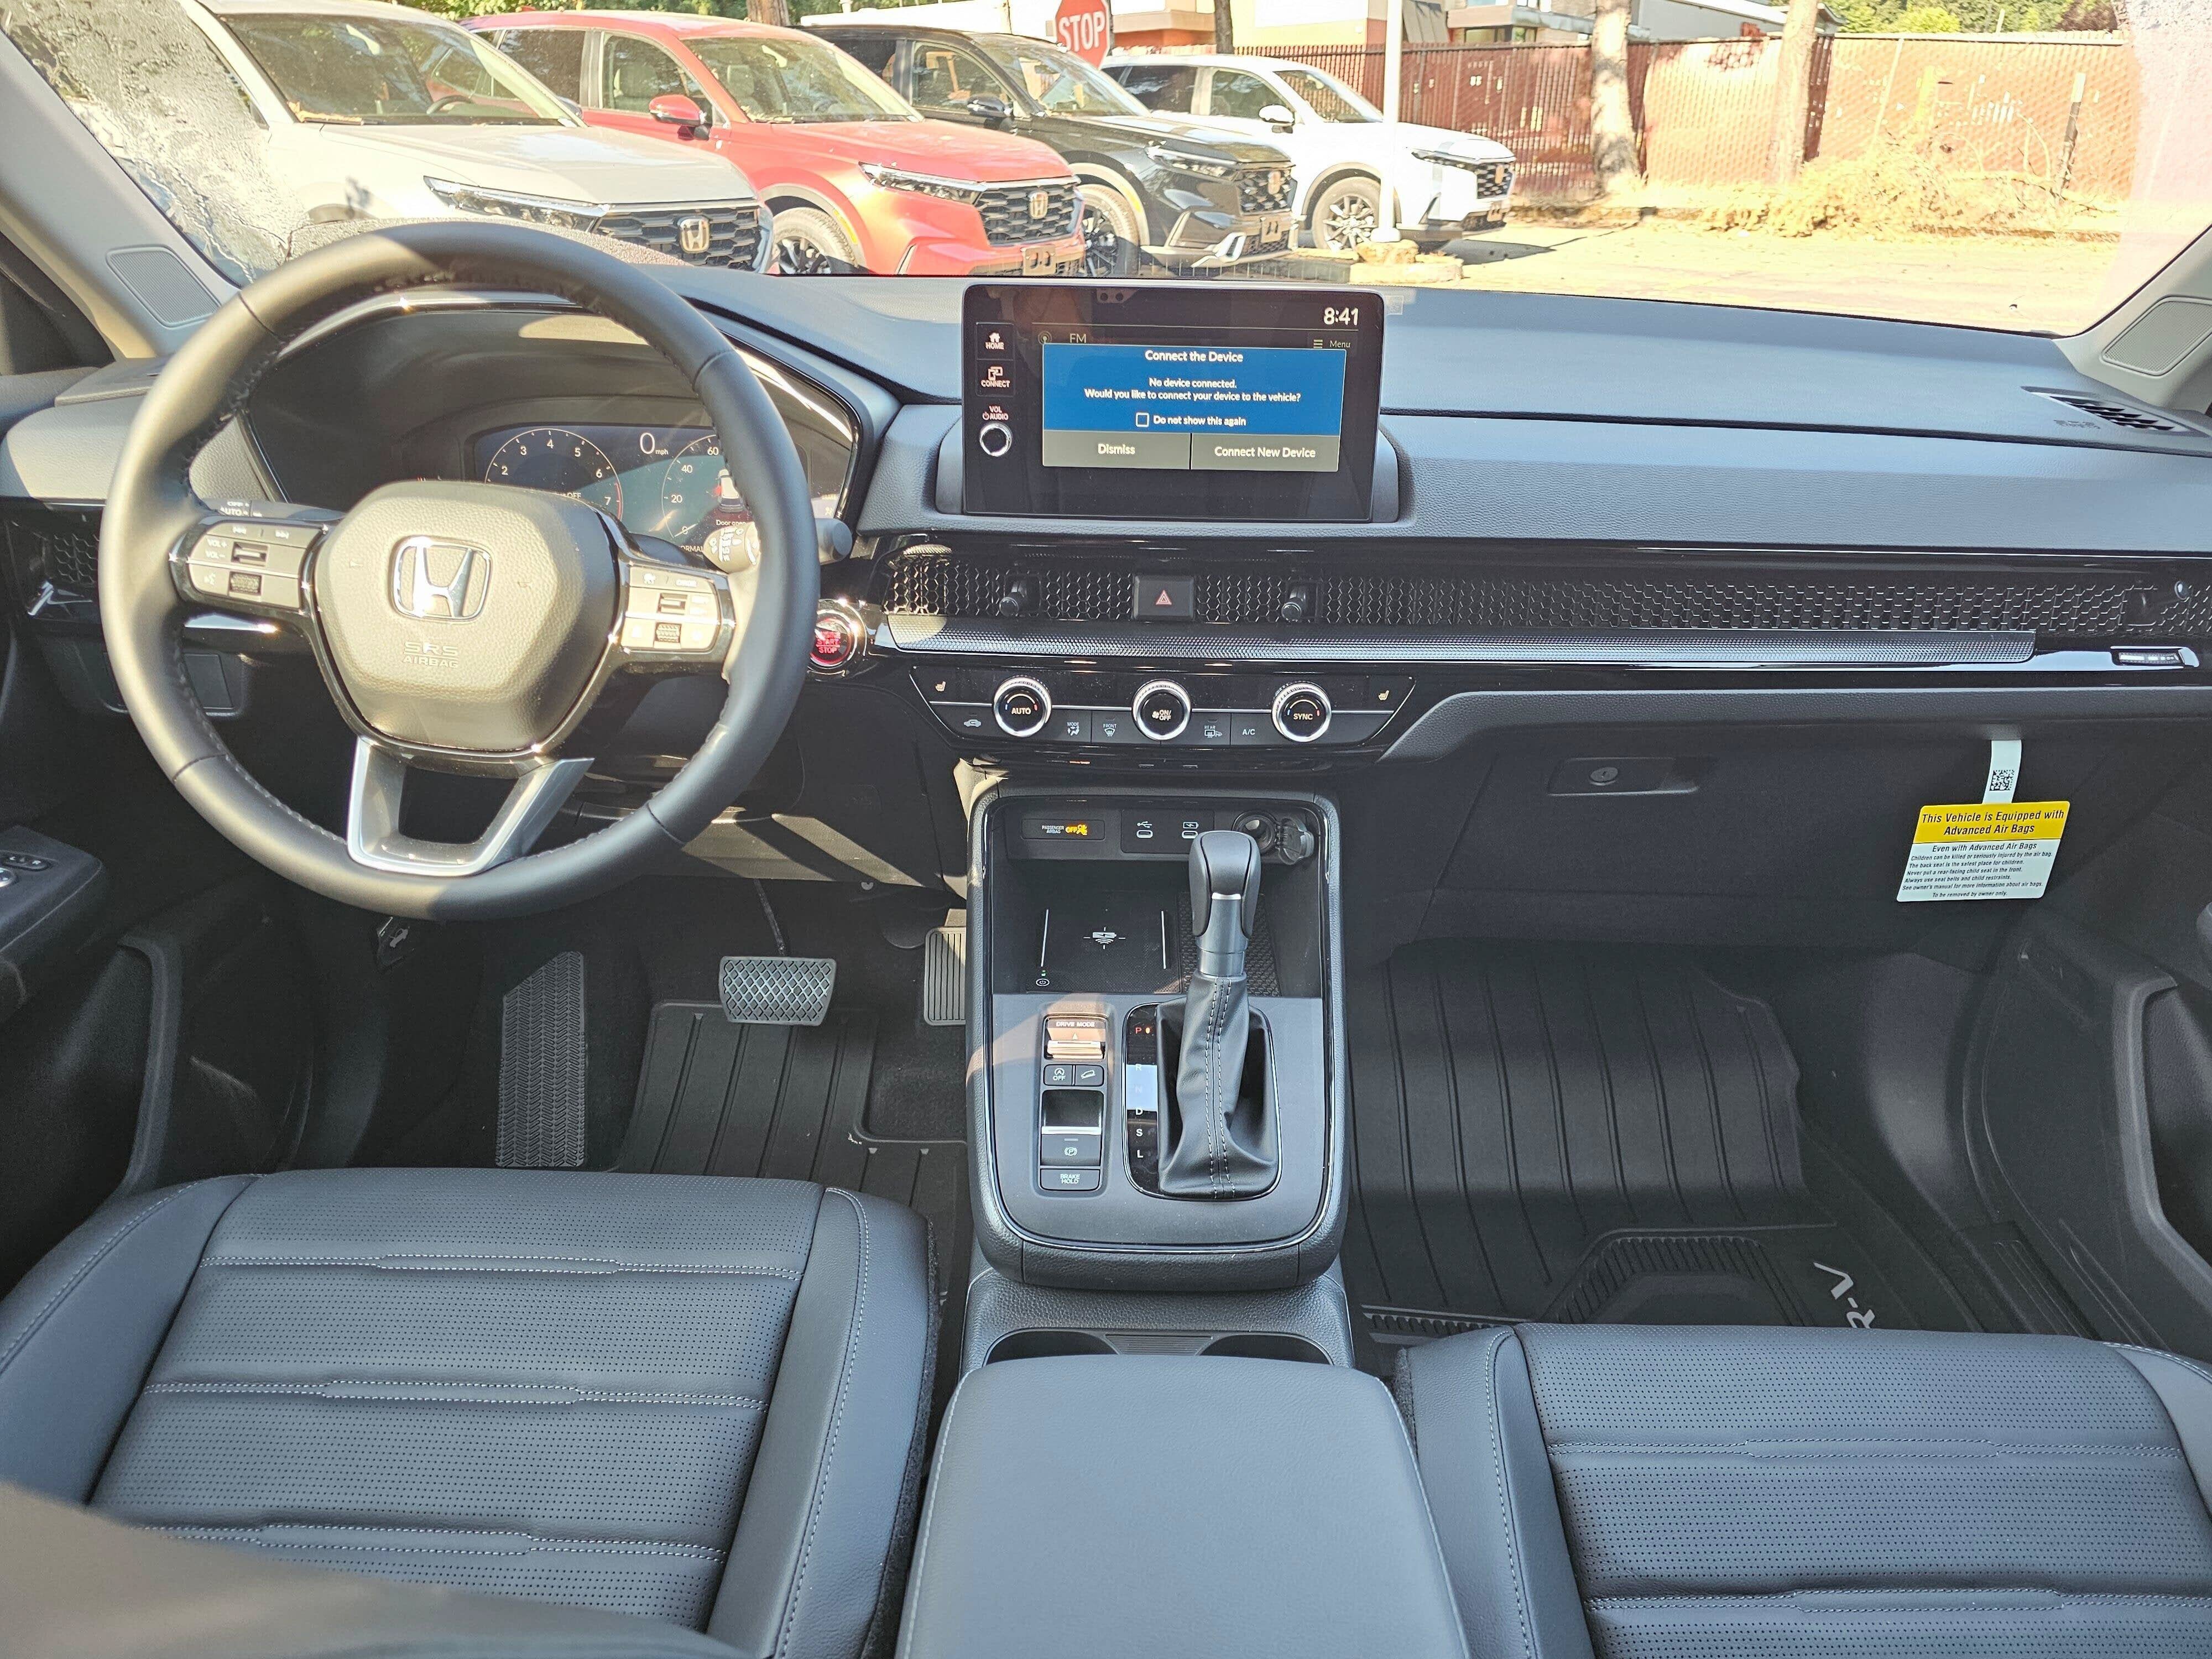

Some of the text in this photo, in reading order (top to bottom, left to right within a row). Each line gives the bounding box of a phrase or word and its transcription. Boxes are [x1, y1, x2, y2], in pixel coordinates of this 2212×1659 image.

[1058, 11, 1106, 53] STOP
[1323, 307, 1359, 326] 8:41
[1070, 333, 1087, 343] FM
[1145, 349, 1244, 362] Connect the Device
[1149, 378, 1237, 388] No device connected.
[1084, 389, 1301, 402] Would you like to connect your device to the vehicle?
[1154, 415, 1246, 426] Do not show this again
[547, 439, 554, 448] 4
[639, 432, 655, 454] 0
[520, 446, 527, 455] 3
[575, 447, 581, 457] 5
[707, 447, 719, 455] 60
[1098, 444, 1135, 455] Dismiss
[1214, 447, 1316, 458] Connect New Device
[501, 466, 509, 475] 2
[596, 469, 602, 478] 6
[681, 465, 693, 473] 40
[604, 497, 611, 505] 7
[671, 495, 683, 503] 20
[221, 507, 242, 516] AUTO
[404, 641, 458, 656] SRS
[403, 655, 458, 668] AIRBAG
[1922, 810, 2064, 823] This Vehicle is Equipped with
[1944, 824, 2034, 835] Advanced Air Bags
[1137, 1150, 1144, 1158] L
